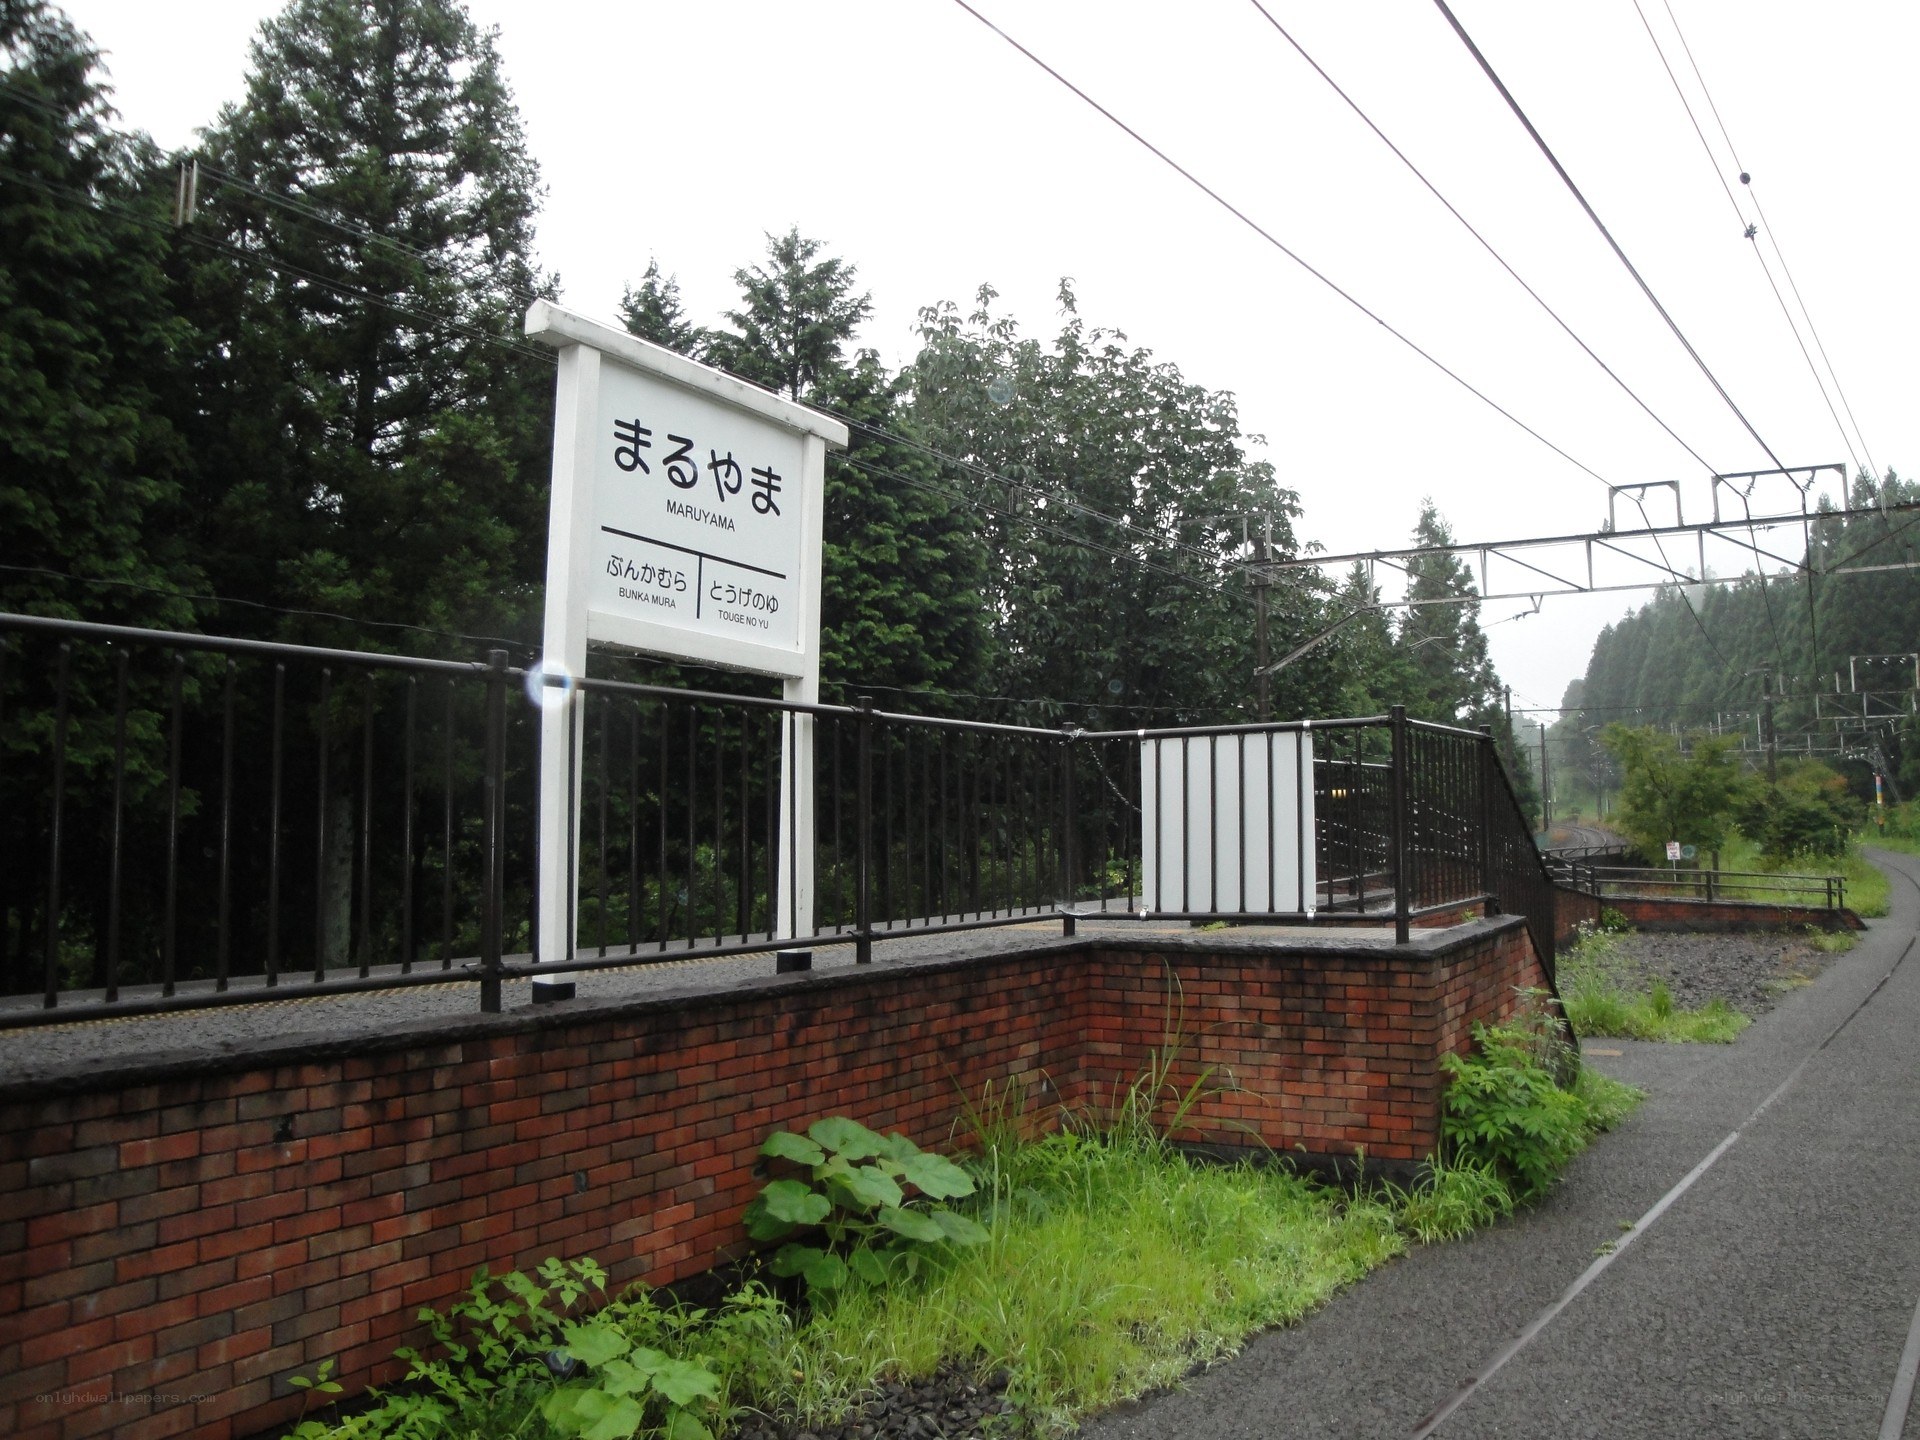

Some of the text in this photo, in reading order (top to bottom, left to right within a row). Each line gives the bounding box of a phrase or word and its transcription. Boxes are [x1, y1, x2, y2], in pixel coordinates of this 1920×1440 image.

[613, 418, 782, 516] まるやま
[666, 499, 735, 532] MARUYAMA
[619, 587, 676, 609] BUNKA MURA
[710, 580, 779, 614] とうげのゆ
[718, 609, 769, 630] TOUGE NO YU
